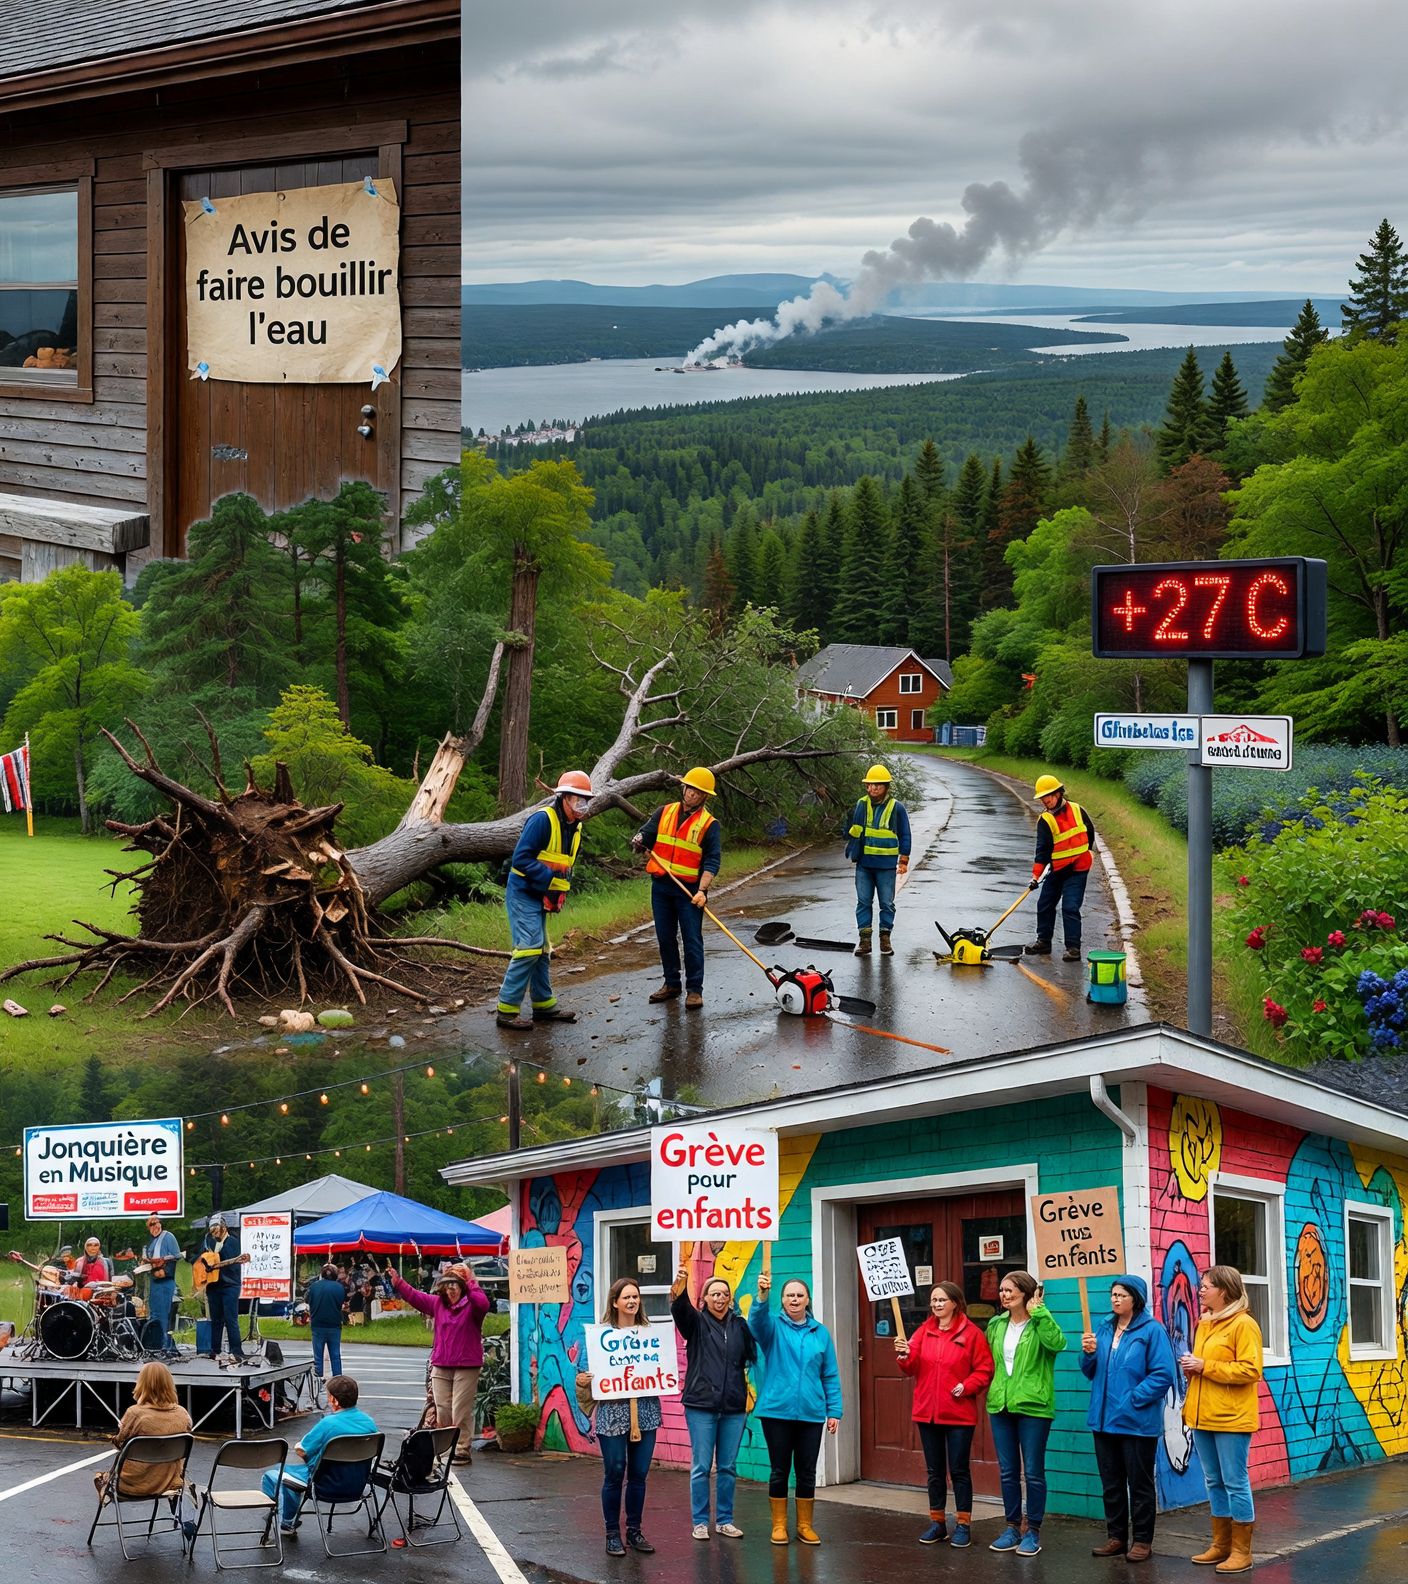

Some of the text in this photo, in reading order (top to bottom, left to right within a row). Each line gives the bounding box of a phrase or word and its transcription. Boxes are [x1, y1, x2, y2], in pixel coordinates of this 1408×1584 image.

[228, 215, 351, 256] Avis de
[196, 258, 393, 303] faire bouillir
[248, 311, 328, 346] l'eau
[1113, 572, 1289, 641] +27 C
[38, 1131, 167, 1163] Jonquière
[659, 1131, 766, 1168] Grève
[39, 1160, 168, 1187] en Musique
[687, 1173, 737, 1195] pour
[656, 1195, 773, 1230] enfants
[1039, 1195, 1104, 1223] Grève
[1044, 1243, 1118, 1269] enfants
